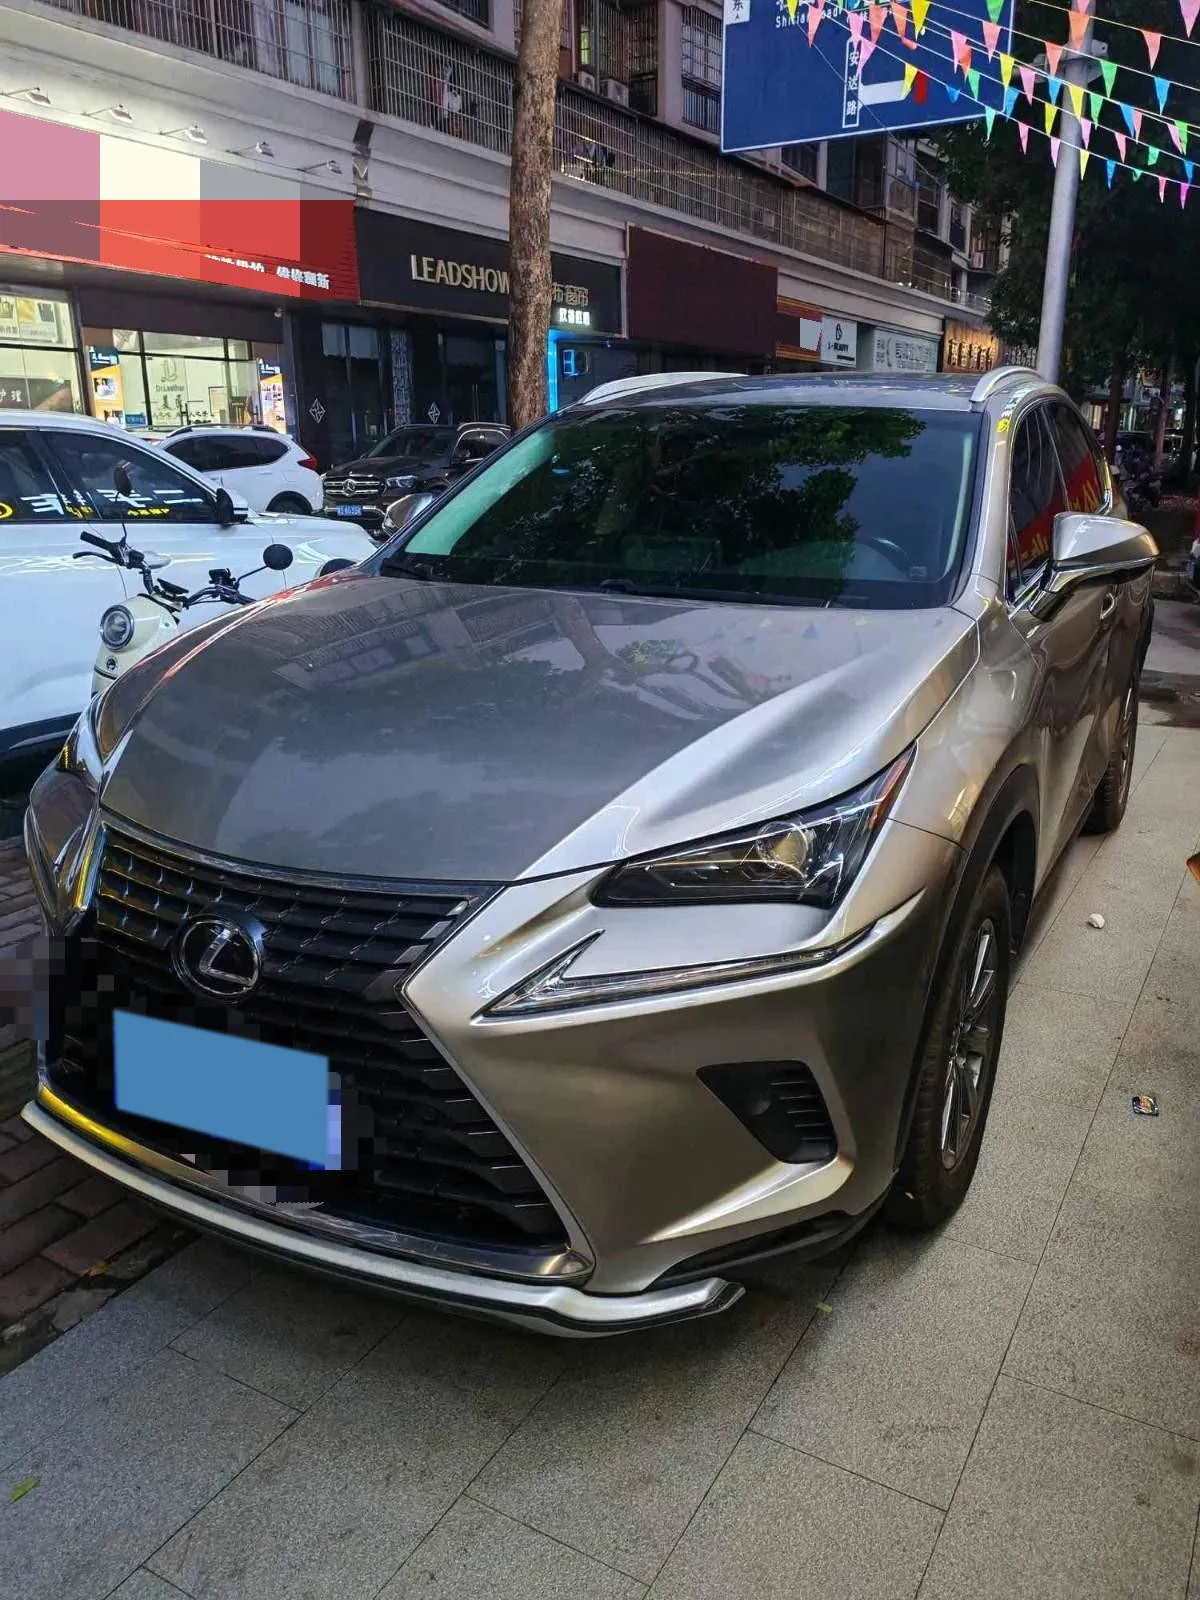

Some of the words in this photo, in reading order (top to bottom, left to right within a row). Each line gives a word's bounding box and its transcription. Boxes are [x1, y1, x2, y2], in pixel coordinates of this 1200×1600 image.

[846, 51, 859, 116] 安达路
[410, 254, 510, 295] LEADSHOW
